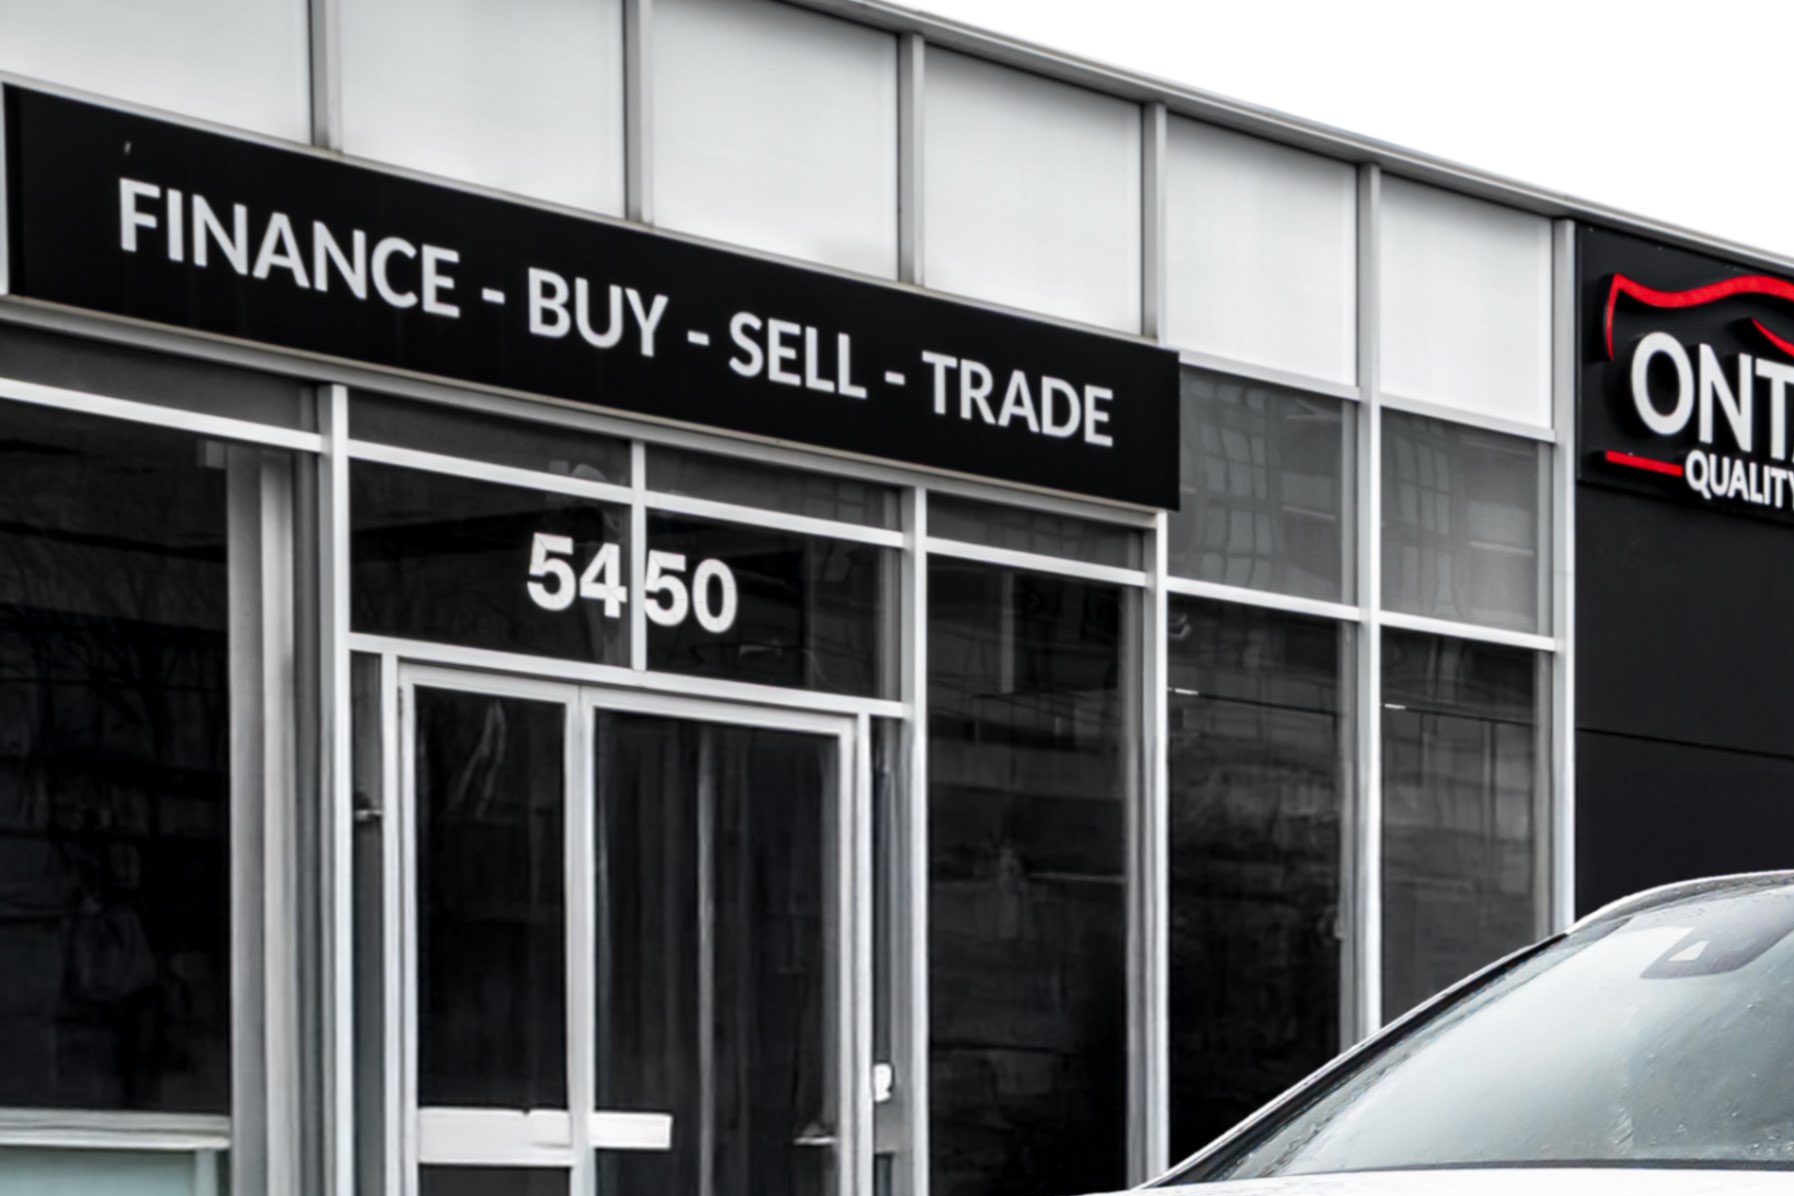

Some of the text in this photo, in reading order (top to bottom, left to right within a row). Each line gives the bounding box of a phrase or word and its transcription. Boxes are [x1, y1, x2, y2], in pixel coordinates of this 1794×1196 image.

[119, 178, 460, 318] FINANCE
[528, 267, 669, 357] BUY
[729, 312, 867, 399] SELL
[921, 350, 1114, 447] TRADE
[526, 532, 738, 634] 5450
